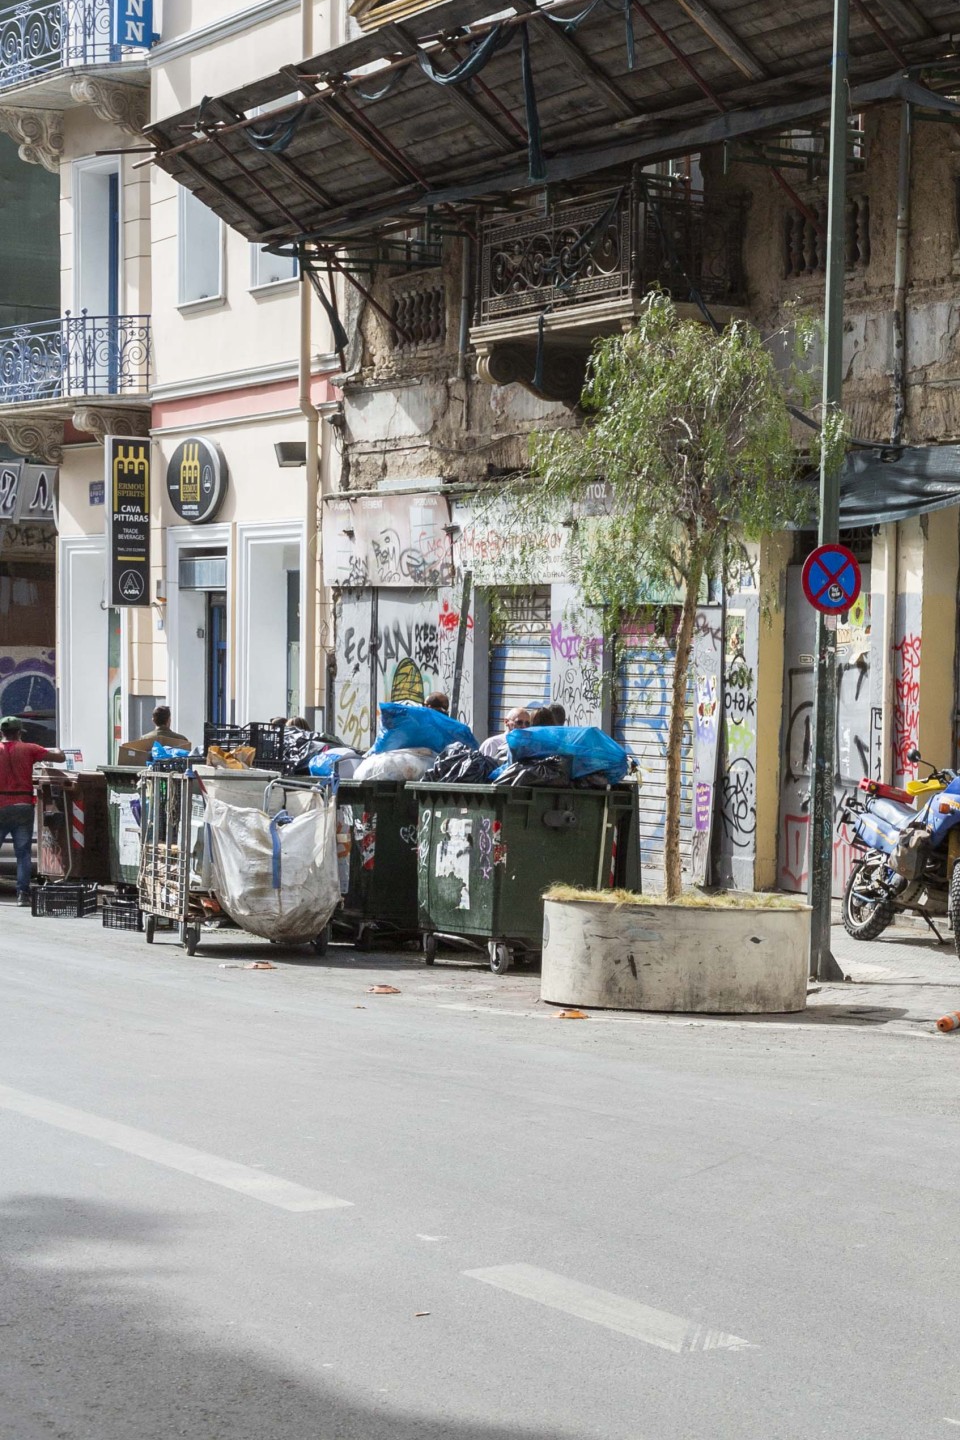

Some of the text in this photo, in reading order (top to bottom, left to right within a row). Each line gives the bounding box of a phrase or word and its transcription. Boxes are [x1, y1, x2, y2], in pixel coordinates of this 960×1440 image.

[118, 482, 145, 491] ERMOU
[117, 490, 145, 498] SPIRITS
[121, 505, 141, 513] CAVA
[113, 513, 149, 523] PITTARAS
[117, 533, 145, 541] BEVERAGES
